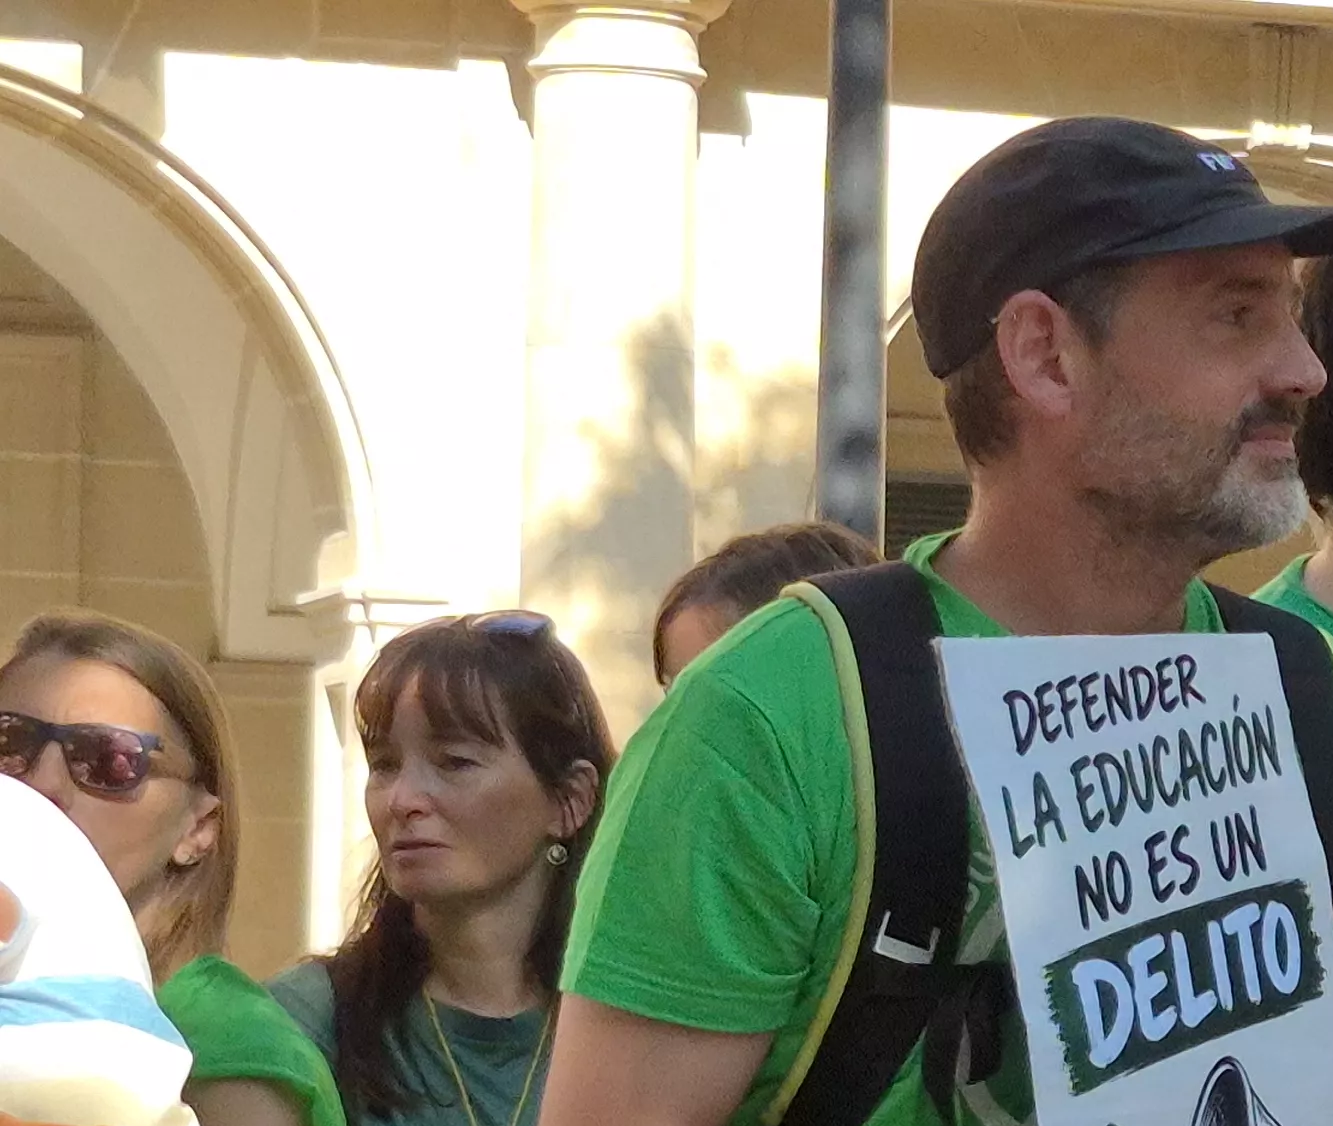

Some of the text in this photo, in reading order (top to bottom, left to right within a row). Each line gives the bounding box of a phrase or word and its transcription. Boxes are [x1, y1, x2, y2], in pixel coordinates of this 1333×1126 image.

[1001, 695, 1282, 858] LA EDUCACIÓN
[1003, 654, 1205, 755] DEFENDER
[1075, 848, 1133, 930] NO
[1148, 824, 1200, 902] ES
[1211, 805, 1267, 881] UN
[1072, 900, 1301, 1068] DELITO
